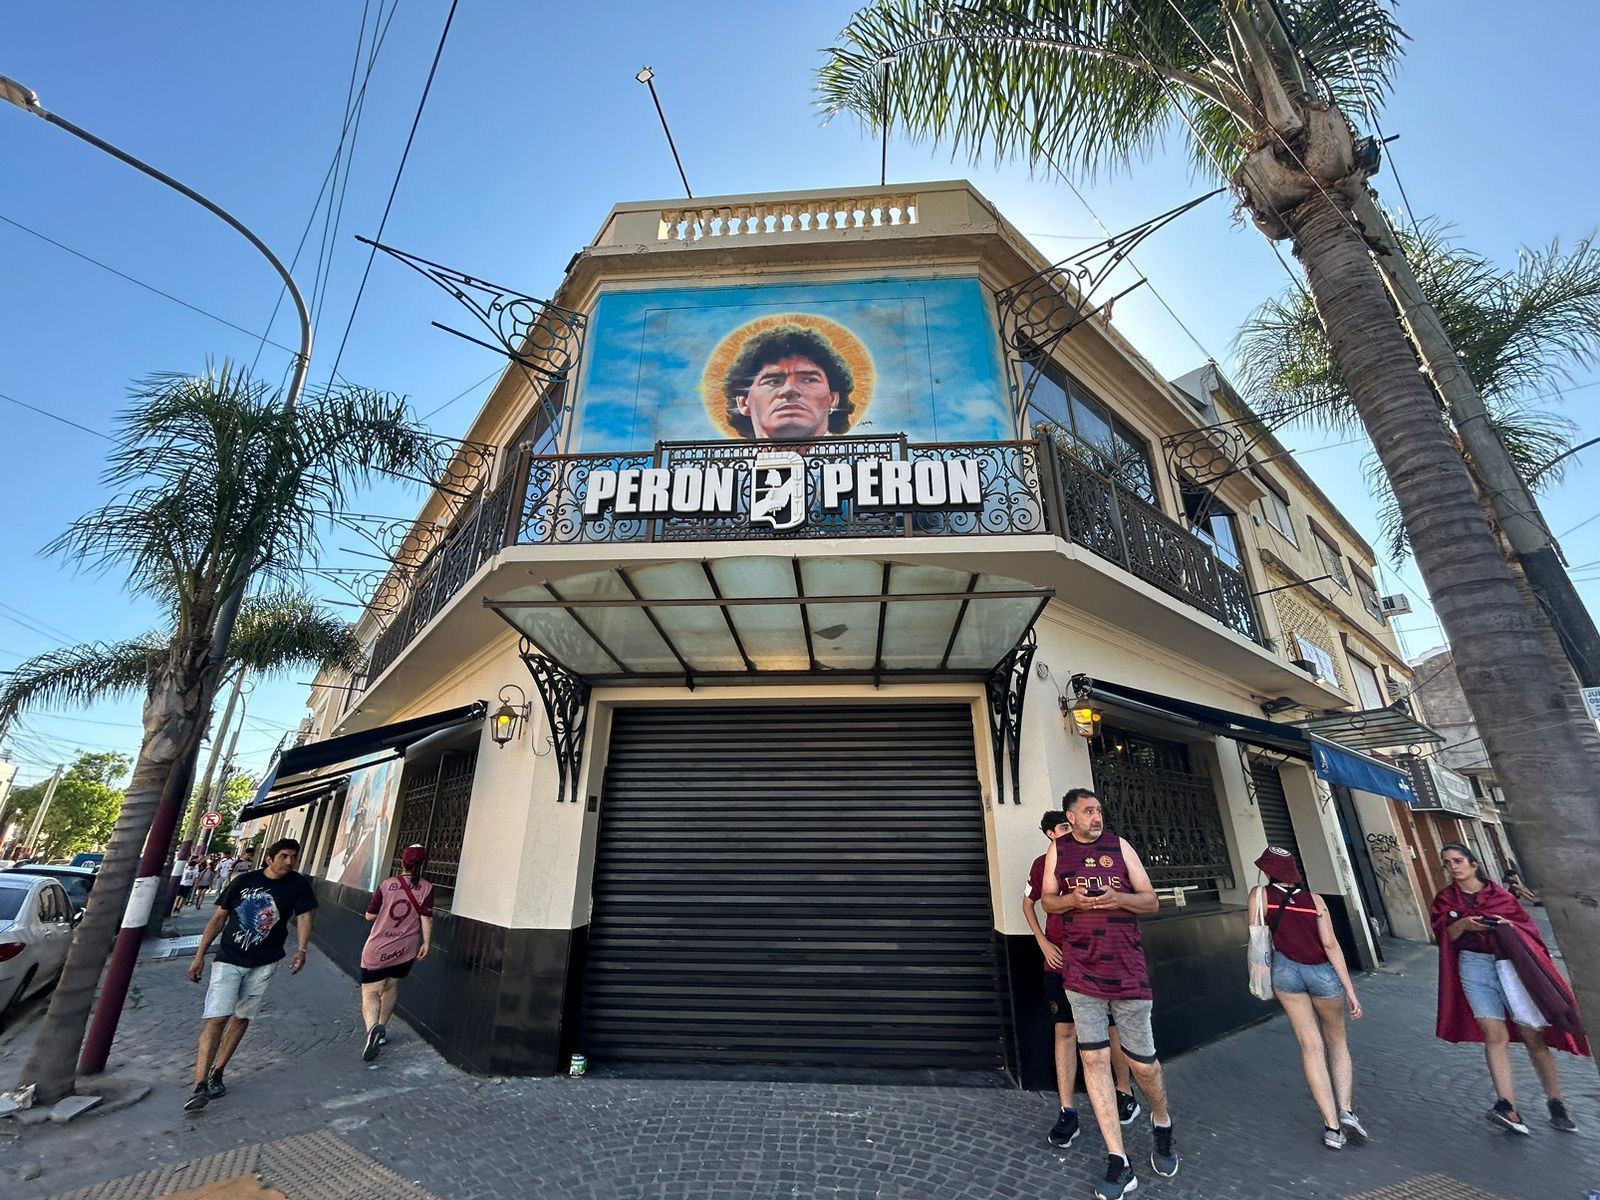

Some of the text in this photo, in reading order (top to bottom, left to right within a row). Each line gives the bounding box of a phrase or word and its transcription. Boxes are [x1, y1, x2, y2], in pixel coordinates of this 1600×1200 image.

[584, 458, 982, 516] PERON PERON
[389, 899, 411, 928] 9
